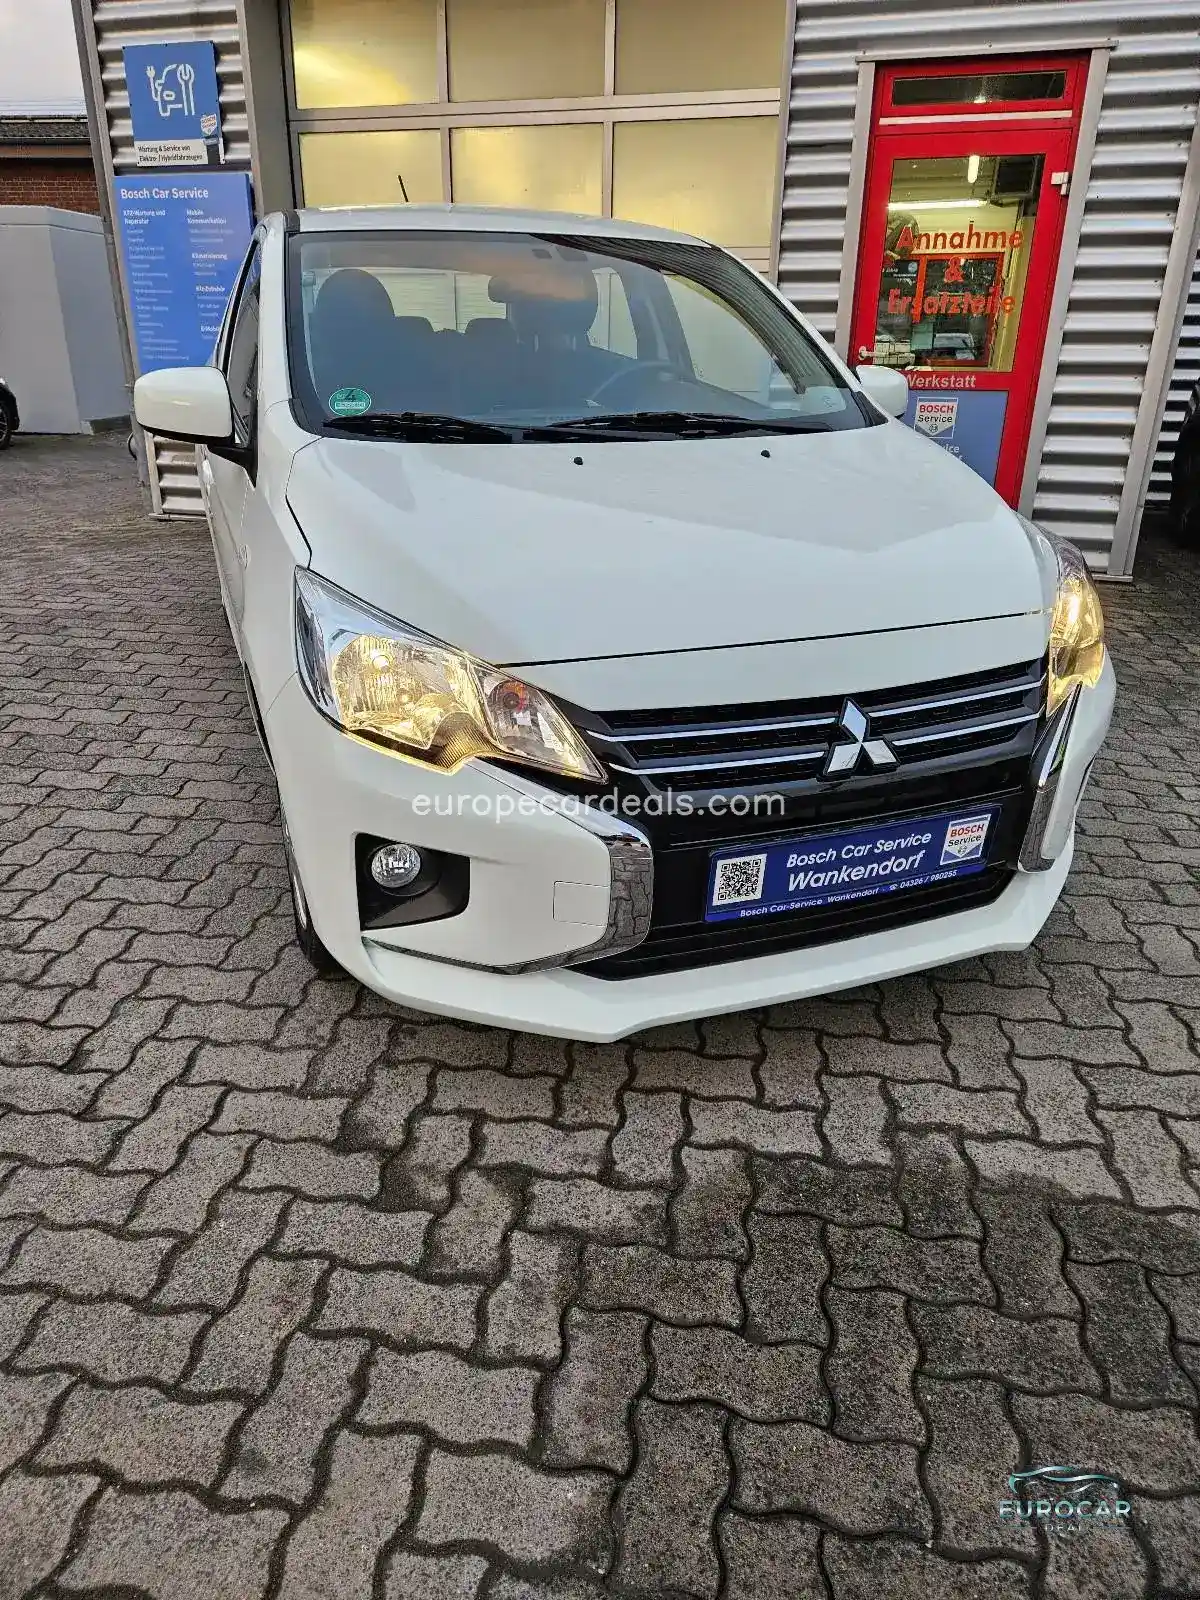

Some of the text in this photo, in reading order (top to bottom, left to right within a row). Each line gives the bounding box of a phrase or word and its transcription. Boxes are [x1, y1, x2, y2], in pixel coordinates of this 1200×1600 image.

[121, 187, 208, 199] Bosch Car Service
[896, 224, 1024, 250] Annahme
[944, 256, 964, 283] &
[907, 375, 976, 388] Werkstatt
[345, 389, 356, 402] 4
[919, 404, 955, 413] BOSCH
[918, 415, 953, 423] Service
[950, 823, 985, 838] BOSCH
[947, 834, 982, 847] Service
[786, 831, 932, 868] Bosch Car Service
[788, 850, 924, 892] Wankendorf
[740, 906, 768, 917] Bosch
[769, 898, 823, 913] Car-Service
[827, 887, 879, 903] Wankendorf
[900, 878, 924, 889] 04326
